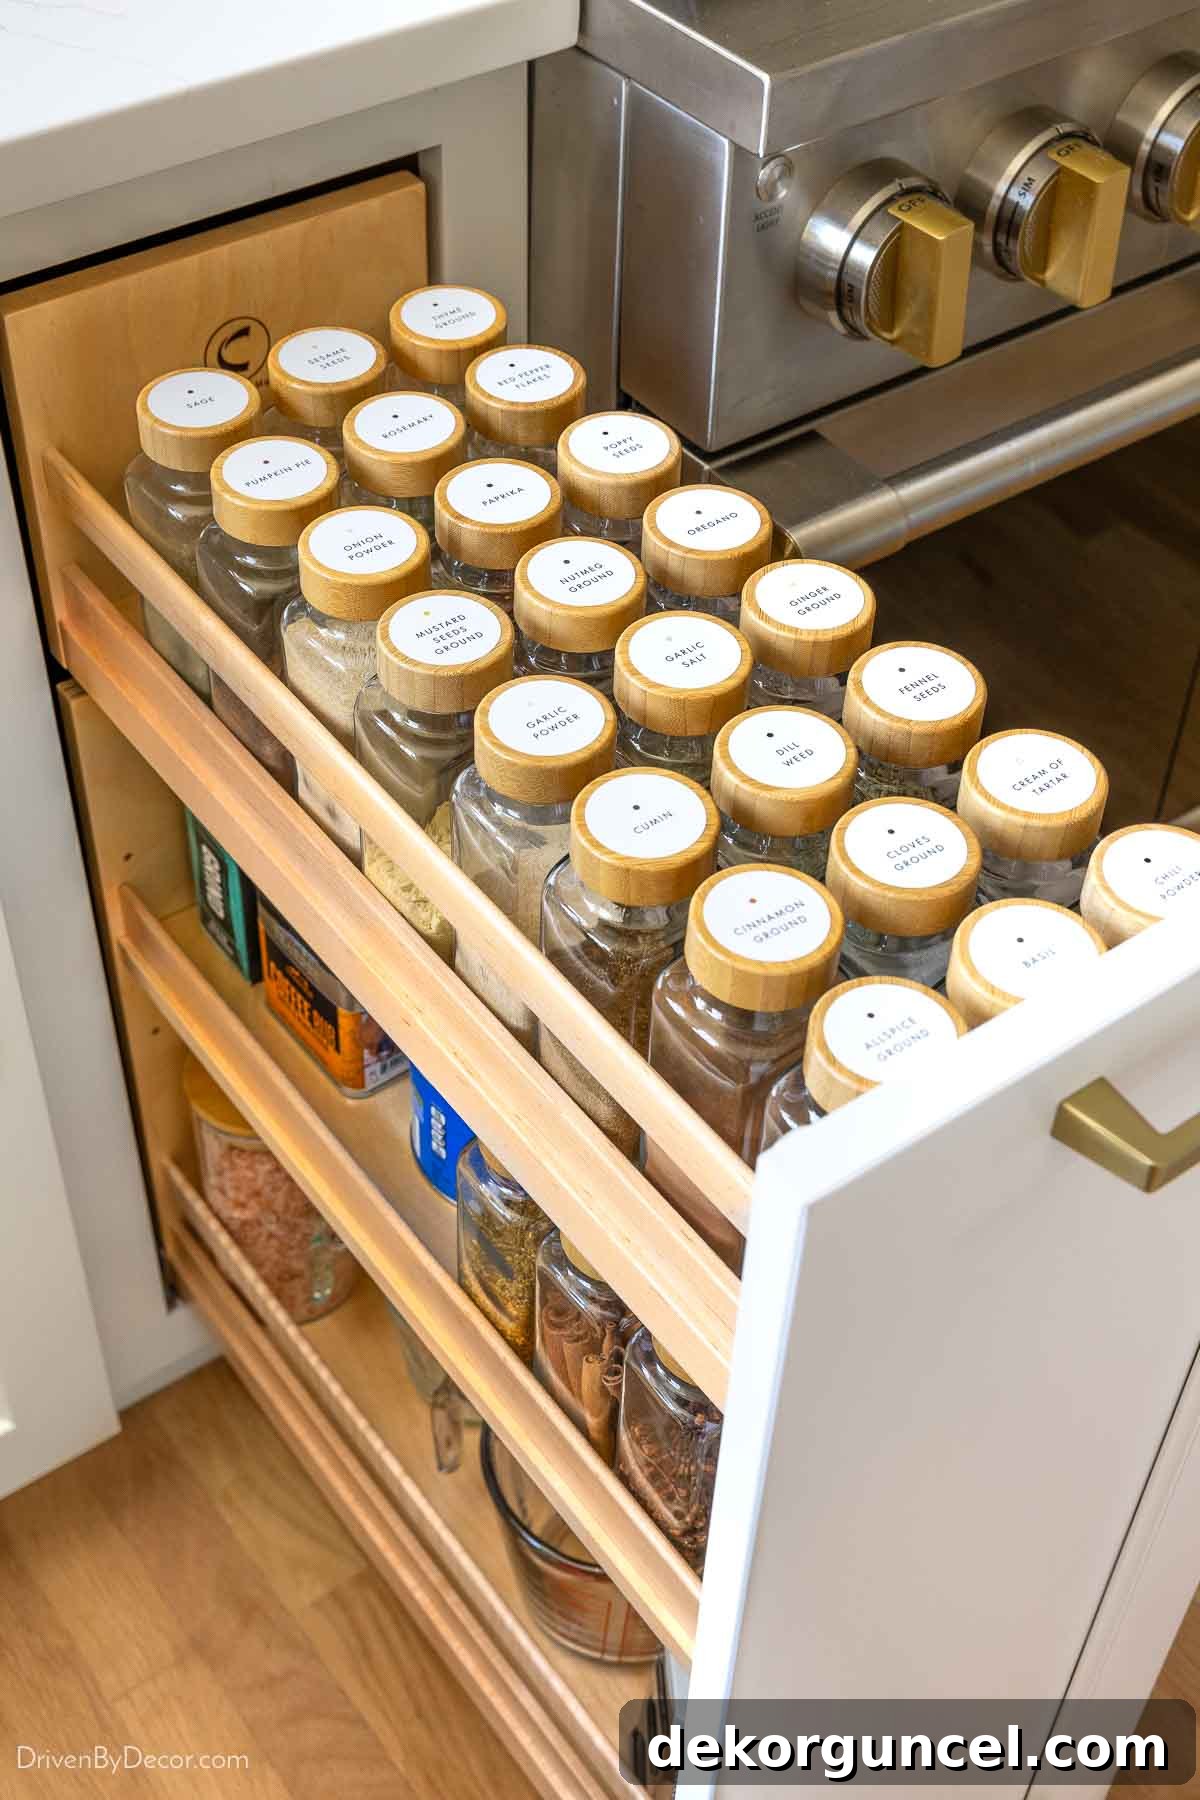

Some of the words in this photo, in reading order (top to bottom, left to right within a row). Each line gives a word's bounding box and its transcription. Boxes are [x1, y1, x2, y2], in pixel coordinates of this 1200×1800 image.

[1018, 176, 1036, 199] SIM
[431, 306, 463, 321] THYME
[434, 311, 477, 329] GROUND
[306, 347, 347, 365] SESAME
[319, 355, 351, 370] SEEDS
[496, 374, 517, 387] RED
[518, 363, 553, 380] PEPPER
[514, 373, 552, 390] FLAKES
[186, 396, 216, 409] SAGE
[381, 413, 434, 440] ROSEMARY
[602, 435, 635, 452] POPPY
[612, 443, 644, 459] SEEDS
[244, 465, 293, 488] PUMPKIN
[295, 457, 312, 469] PIE
[481, 486, 526, 508] PAPRIKA
[687, 512, 739, 536] OREGANO
[343, 532, 385, 552] ONION
[347, 539, 396, 561] POWDER
[559, 562, 604, 585] NUTMEG
[568, 569, 614, 593] GROUND
[789, 584, 830, 608] GINGER
[797, 592, 842, 616] GROUND
[415, 613, 467, 640] MUSTARD
[432, 626, 468, 645] SEEDS
[434, 631, 484, 656] GROUND
[664, 641, 705, 663] GARLIC
[681, 653, 708, 669] SALT
[898, 672, 939, 695] FENNEL
[913, 682, 946, 702] SEEDS
[525, 705, 568, 730] GARLIC
[532, 713, 581, 740] POWDER
[775, 740, 801, 757] DILL
[783, 748, 815, 767] WEED
[1012, 768, 1049, 792] CREAM
[1049, 758, 1065, 771] OF
[1031, 772, 1070, 797] TARTAR
[632, 809, 673, 835] CUMIN
[886, 834, 931, 860] CLOVES
[893, 844, 945, 872] GROUND
[1154, 864, 1183, 886] CHILI
[733, 900, 806, 937] CINNAMON
[753, 915, 808, 944] GROUND
[1022, 948, 1056, 969] BASIL
[864, 1015, 918, 1051] ALLSPICE
[876, 1028, 931, 1062] GROUND
